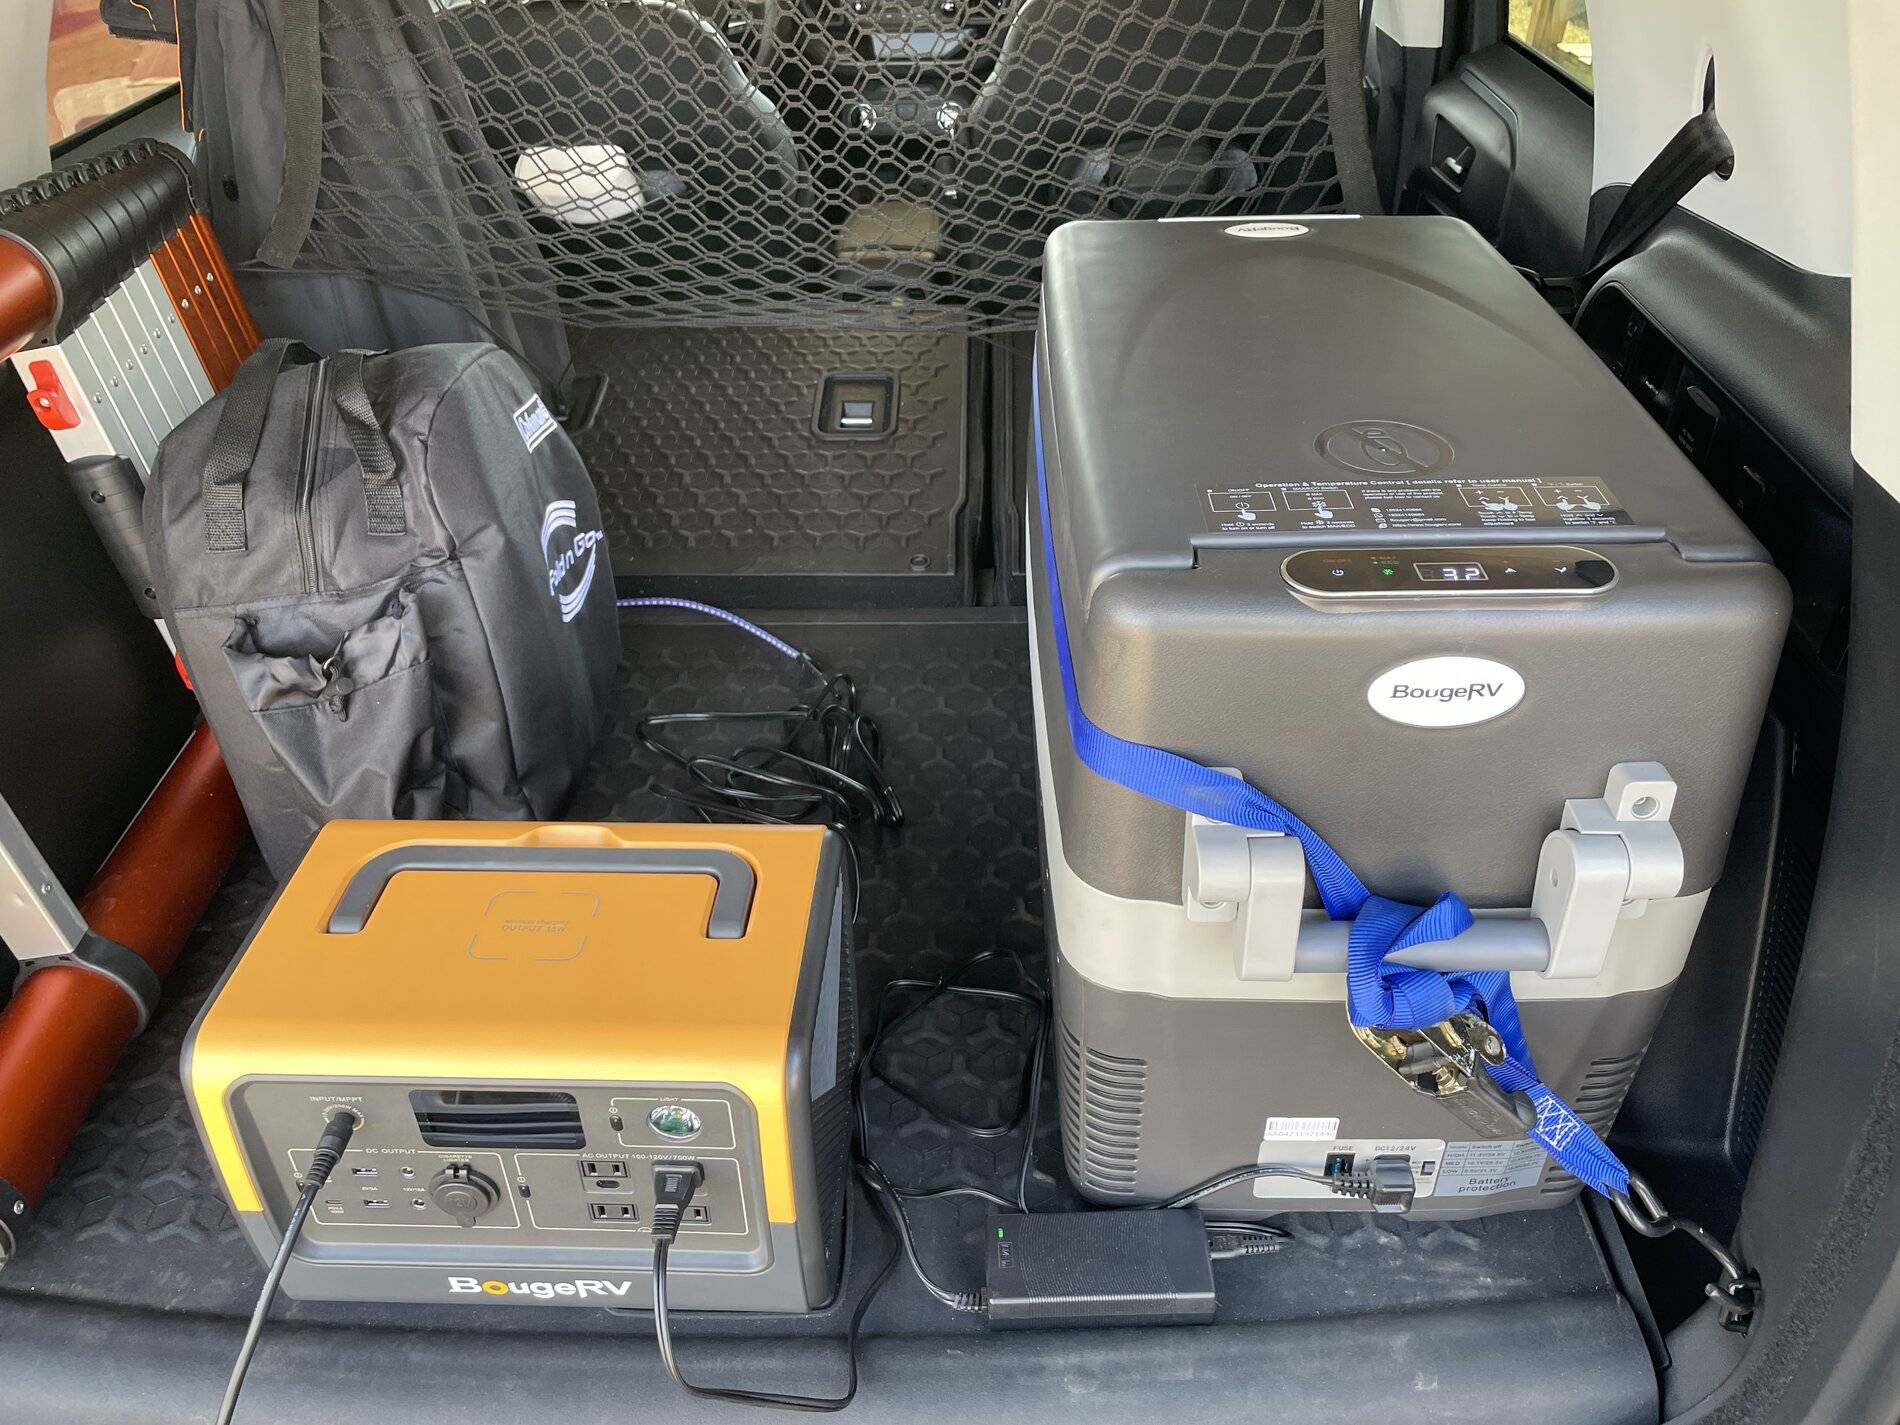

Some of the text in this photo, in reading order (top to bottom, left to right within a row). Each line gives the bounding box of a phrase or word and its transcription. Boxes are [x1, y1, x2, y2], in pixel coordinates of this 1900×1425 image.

[549, 554, 566, 596] Fold
[1388, 683, 1505, 703] BougeRV
[1457, 1181, 1516, 1193] protection
[1468, 1176, 1511, 1185] Battery
[447, 1276, 633, 1299] BougeRV
